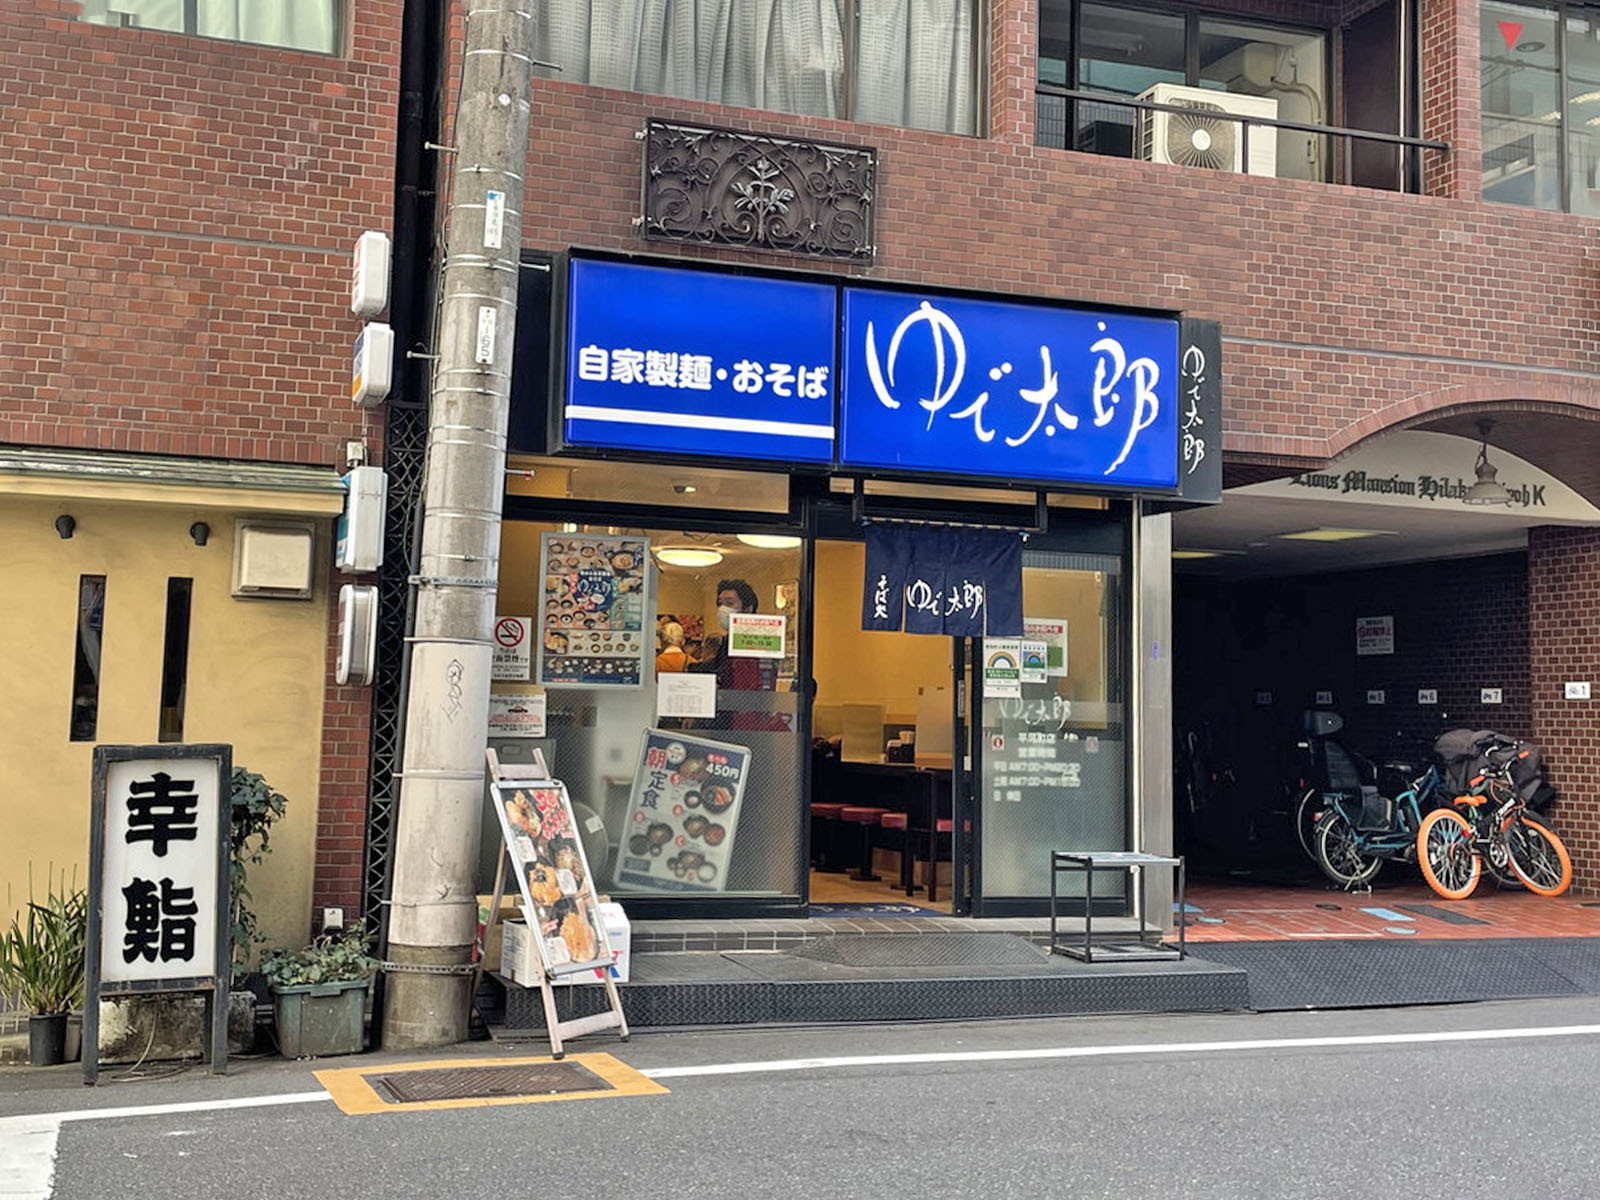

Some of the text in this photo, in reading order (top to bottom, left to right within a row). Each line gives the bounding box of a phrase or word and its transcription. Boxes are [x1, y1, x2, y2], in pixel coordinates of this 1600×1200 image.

[578, 344, 830, 399] 自家製麺・おそば
[865, 299, 1160, 476] ゆで太郎
[1180, 345, 1206, 475] ゆで太郎
[1341, 470, 1416, 496] Mansion
[906, 579, 984, 620] ゆで太郎
[640, 747, 668, 810] 朝定食
[705, 762, 740, 779] 450円
[121, 771, 199, 964] 幸鮨
